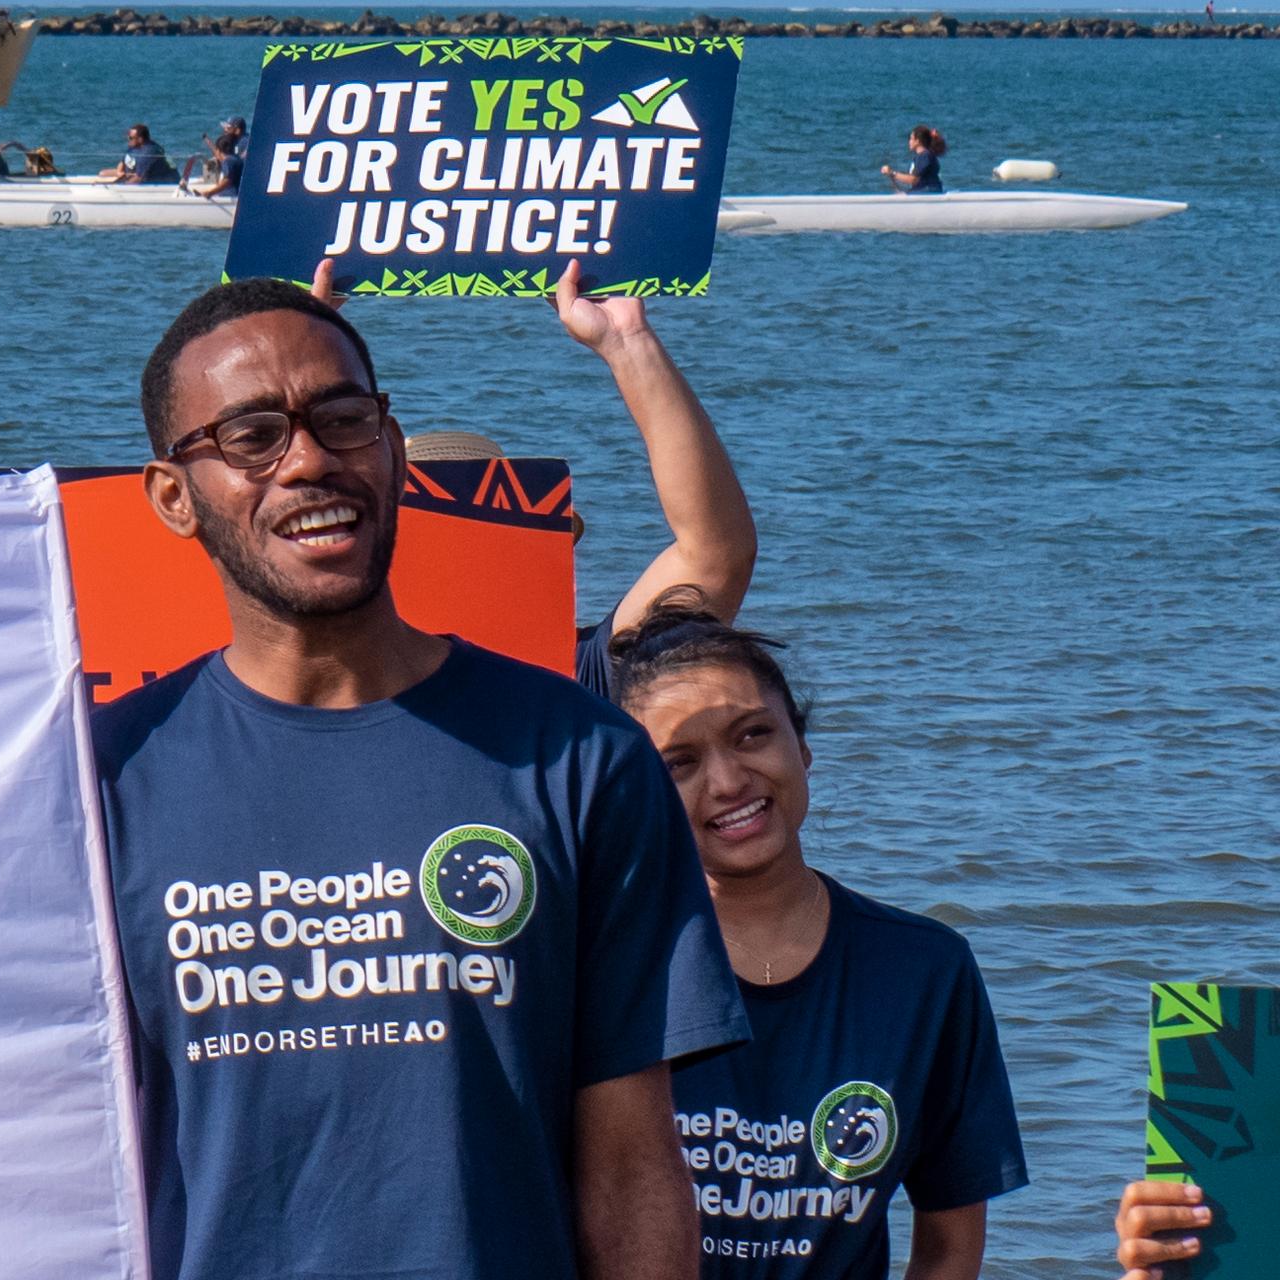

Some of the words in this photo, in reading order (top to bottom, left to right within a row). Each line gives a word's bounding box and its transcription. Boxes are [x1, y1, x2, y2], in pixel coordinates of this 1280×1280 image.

[290, 80, 448, 135] VOTE
[469, 78, 584, 131] YES
[266, 139, 397, 194] FOR
[418, 136, 701, 192] CLIMATE
[52, 210, 72, 225] 22
[324, 199, 618, 256] JUSTICE!
[164, 880, 253, 918] One
[259, 862, 411, 909] People
[168, 919, 255, 959] One
[261, 909, 404, 947] Ocean
[175, 960, 284, 1013] One
[291, 948, 517, 1006] Journey
[186, 1020, 447, 1061] #ENDORSETHEAO
[673, 1111, 712, 1137] ne
[714, 1107, 806, 1152] People
[713, 1141, 797, 1179] Ocean
[723, 1178, 877, 1223] Journey
